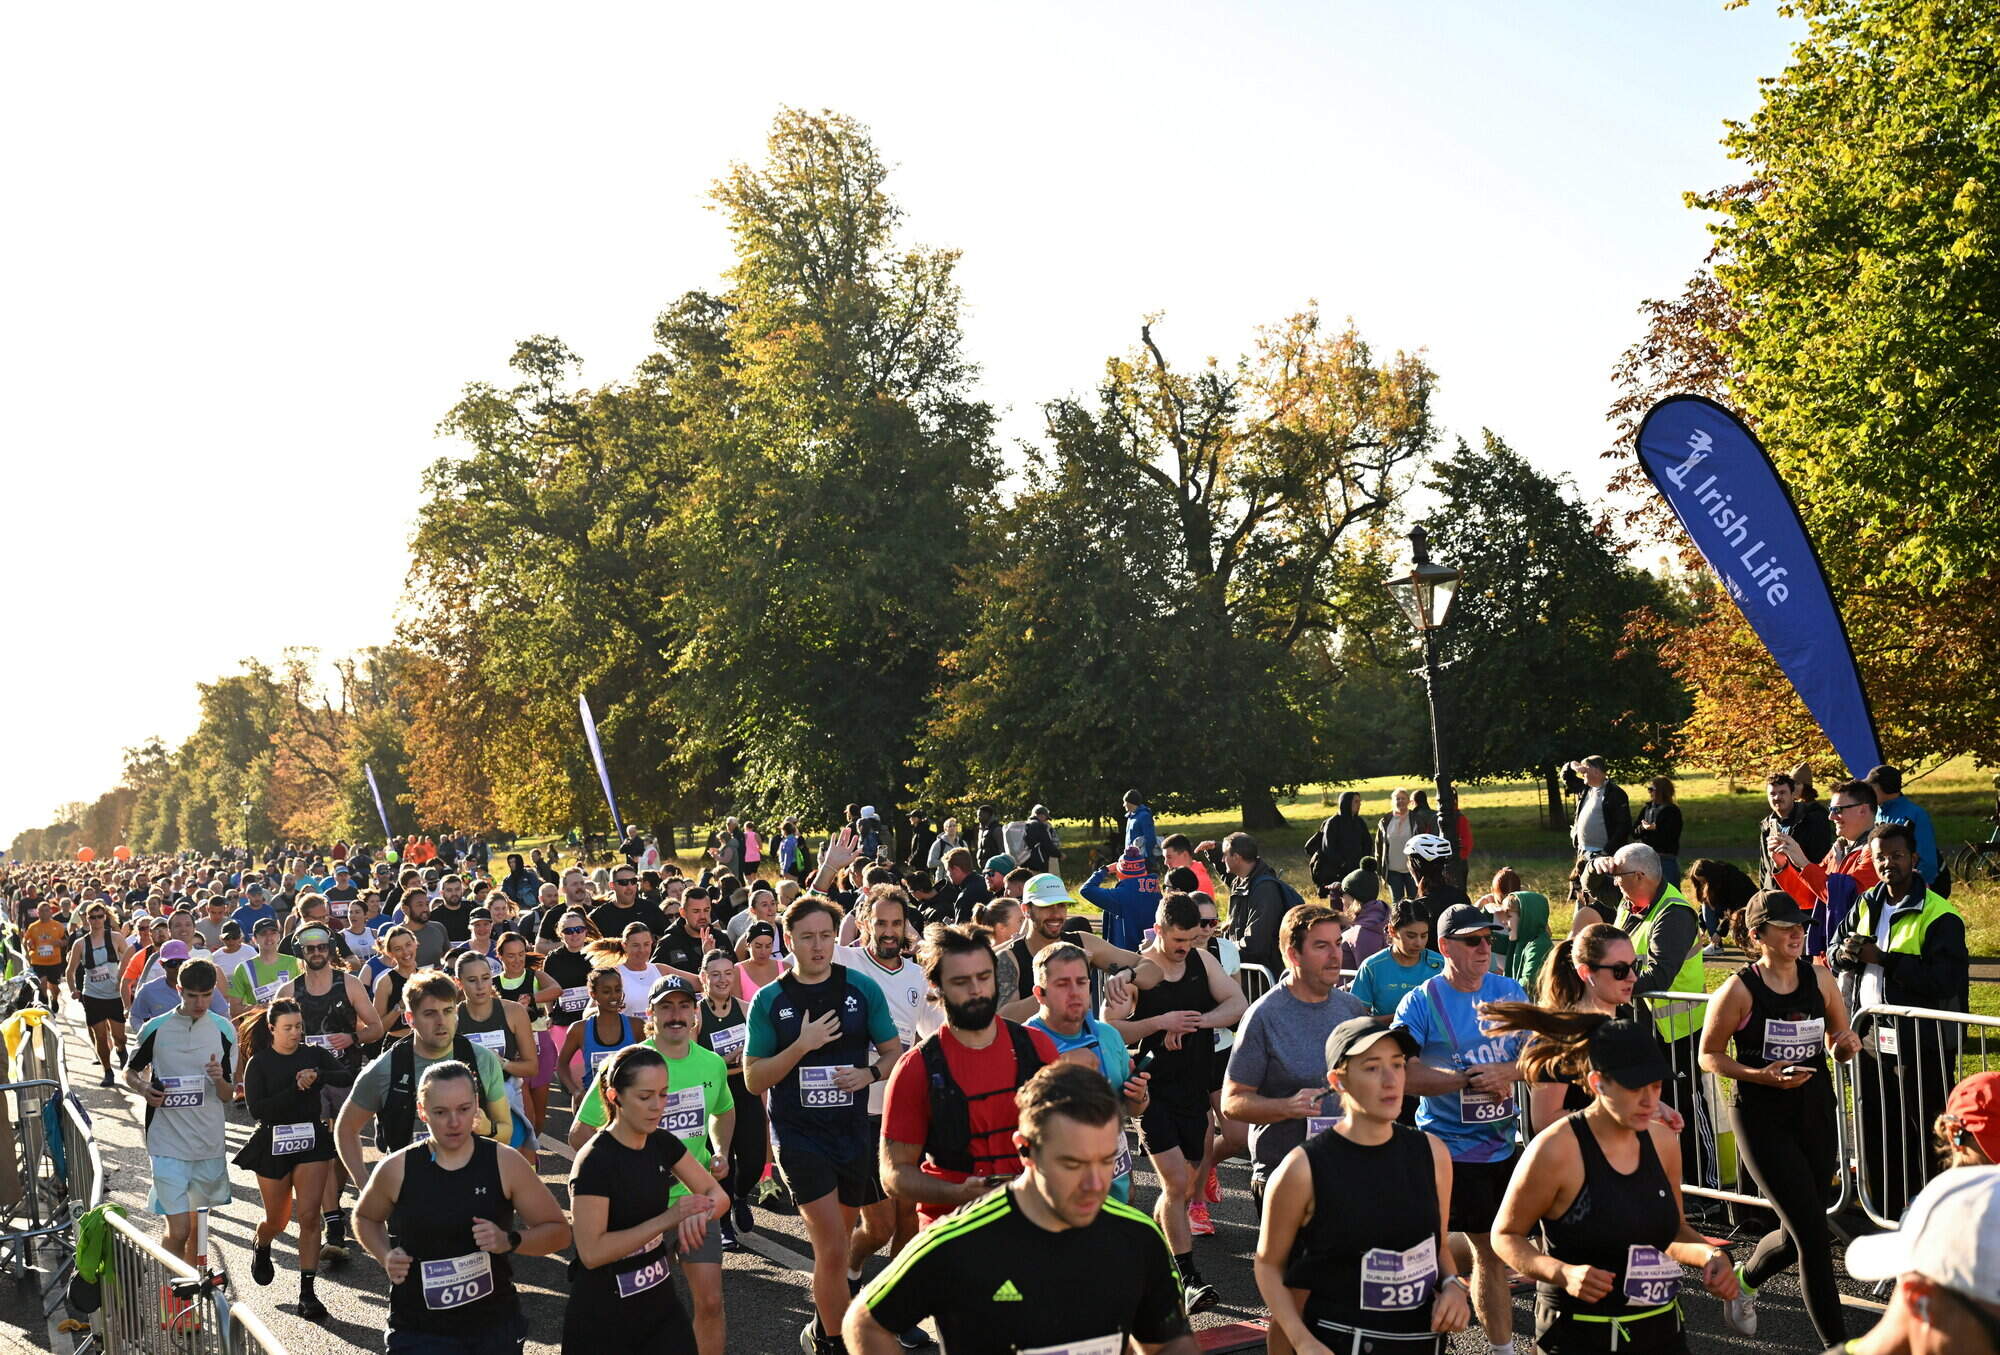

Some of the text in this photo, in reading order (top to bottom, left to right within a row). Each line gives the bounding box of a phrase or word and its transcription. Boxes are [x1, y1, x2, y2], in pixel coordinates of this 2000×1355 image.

[1694, 475, 1789, 607] Irish Life
[565, 1000, 587, 1010] 5517
[1464, 1035, 1510, 1064] 10K
[1771, 1045, 1816, 1060] 4098
[164, 1094, 198, 1106] 6926
[807, 1090, 847, 1104] 6385
[1475, 1102, 1505, 1119] 636
[661, 1112, 697, 1129] 1502
[277, 1140, 309, 1152] 7020
[634, 1260, 664, 1287] 694
[441, 1281, 479, 1304] 670
[1381, 1280, 1425, 1306] 287
